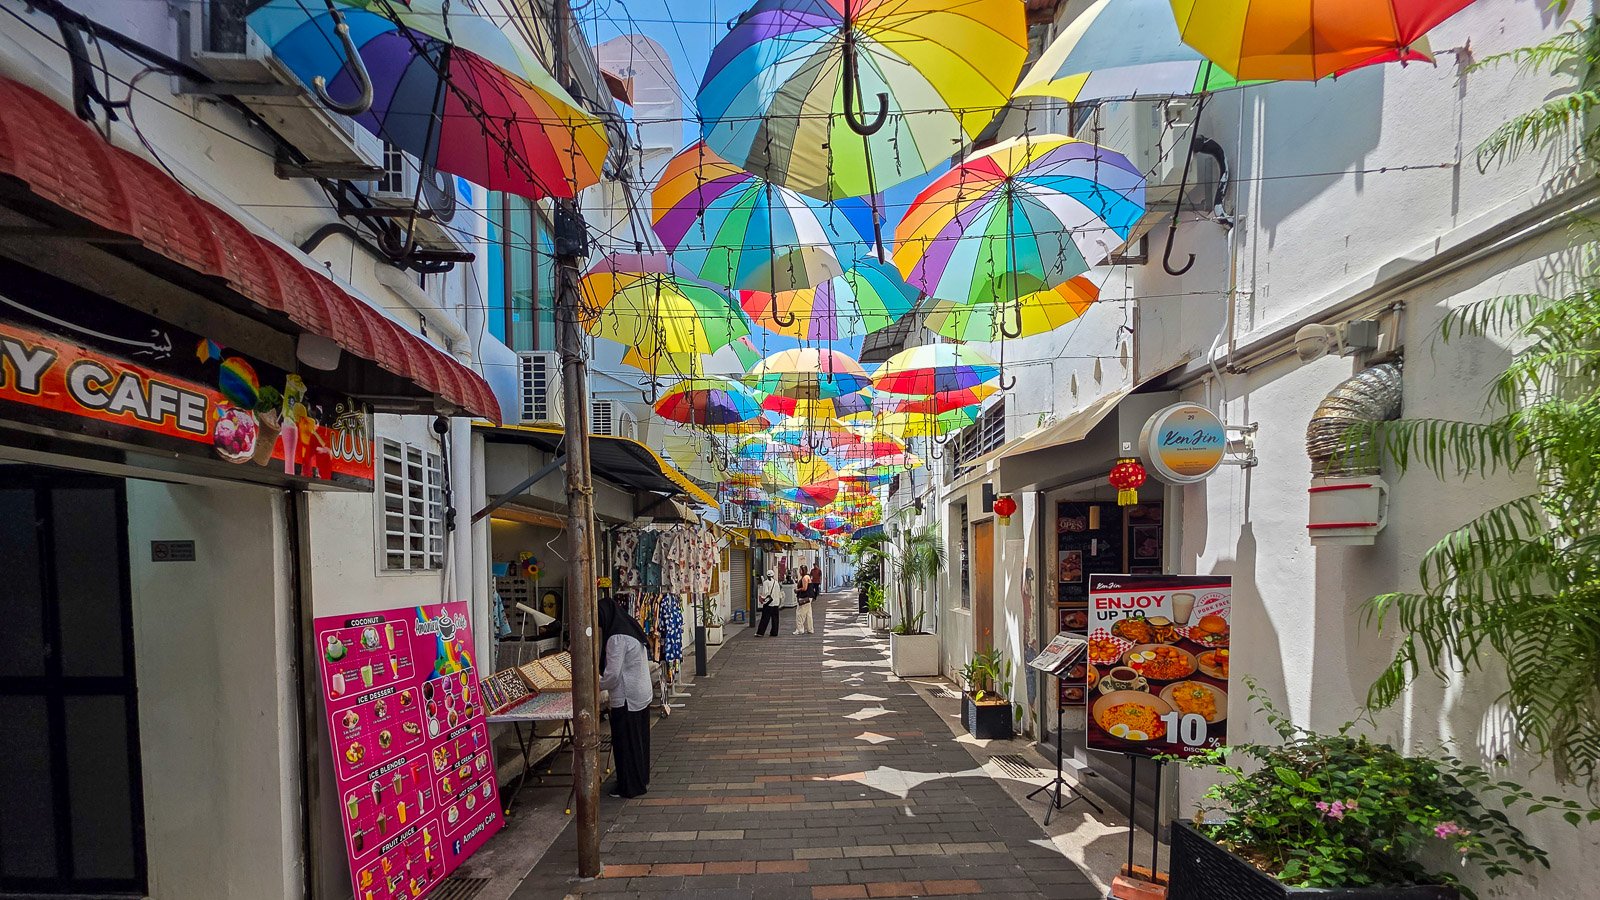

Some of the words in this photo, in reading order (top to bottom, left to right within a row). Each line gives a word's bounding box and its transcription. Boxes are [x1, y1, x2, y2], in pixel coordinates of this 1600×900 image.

[69, 361, 207, 433] CAFE
[1060, 519, 1083, 530] OPEN
[1095, 595, 1165, 609] ENJOY
[1197, 606, 1214, 614] PORK
[1214, 600, 1230, 608] FREE
[350, 616, 379, 627] COCONUT
[1096, 610, 1119, 620] UP
[1122, 609, 1146, 619] TO
[357, 694, 368, 704] ICE
[369, 687, 395, 700] DESSERT
[450, 726, 468, 739] COCKTAIL
[460, 753, 474, 765] CREAM
[368, 769, 380, 780] ICE
[380, 757, 406, 773] BLENDED
[458, 790, 467, 799] HOT
[466, 781, 478, 793] DRINK
[484, 812, 496, 825] Cafe
[381, 838, 399, 853] FRUIT
[399, 827, 415, 842] JUICE
